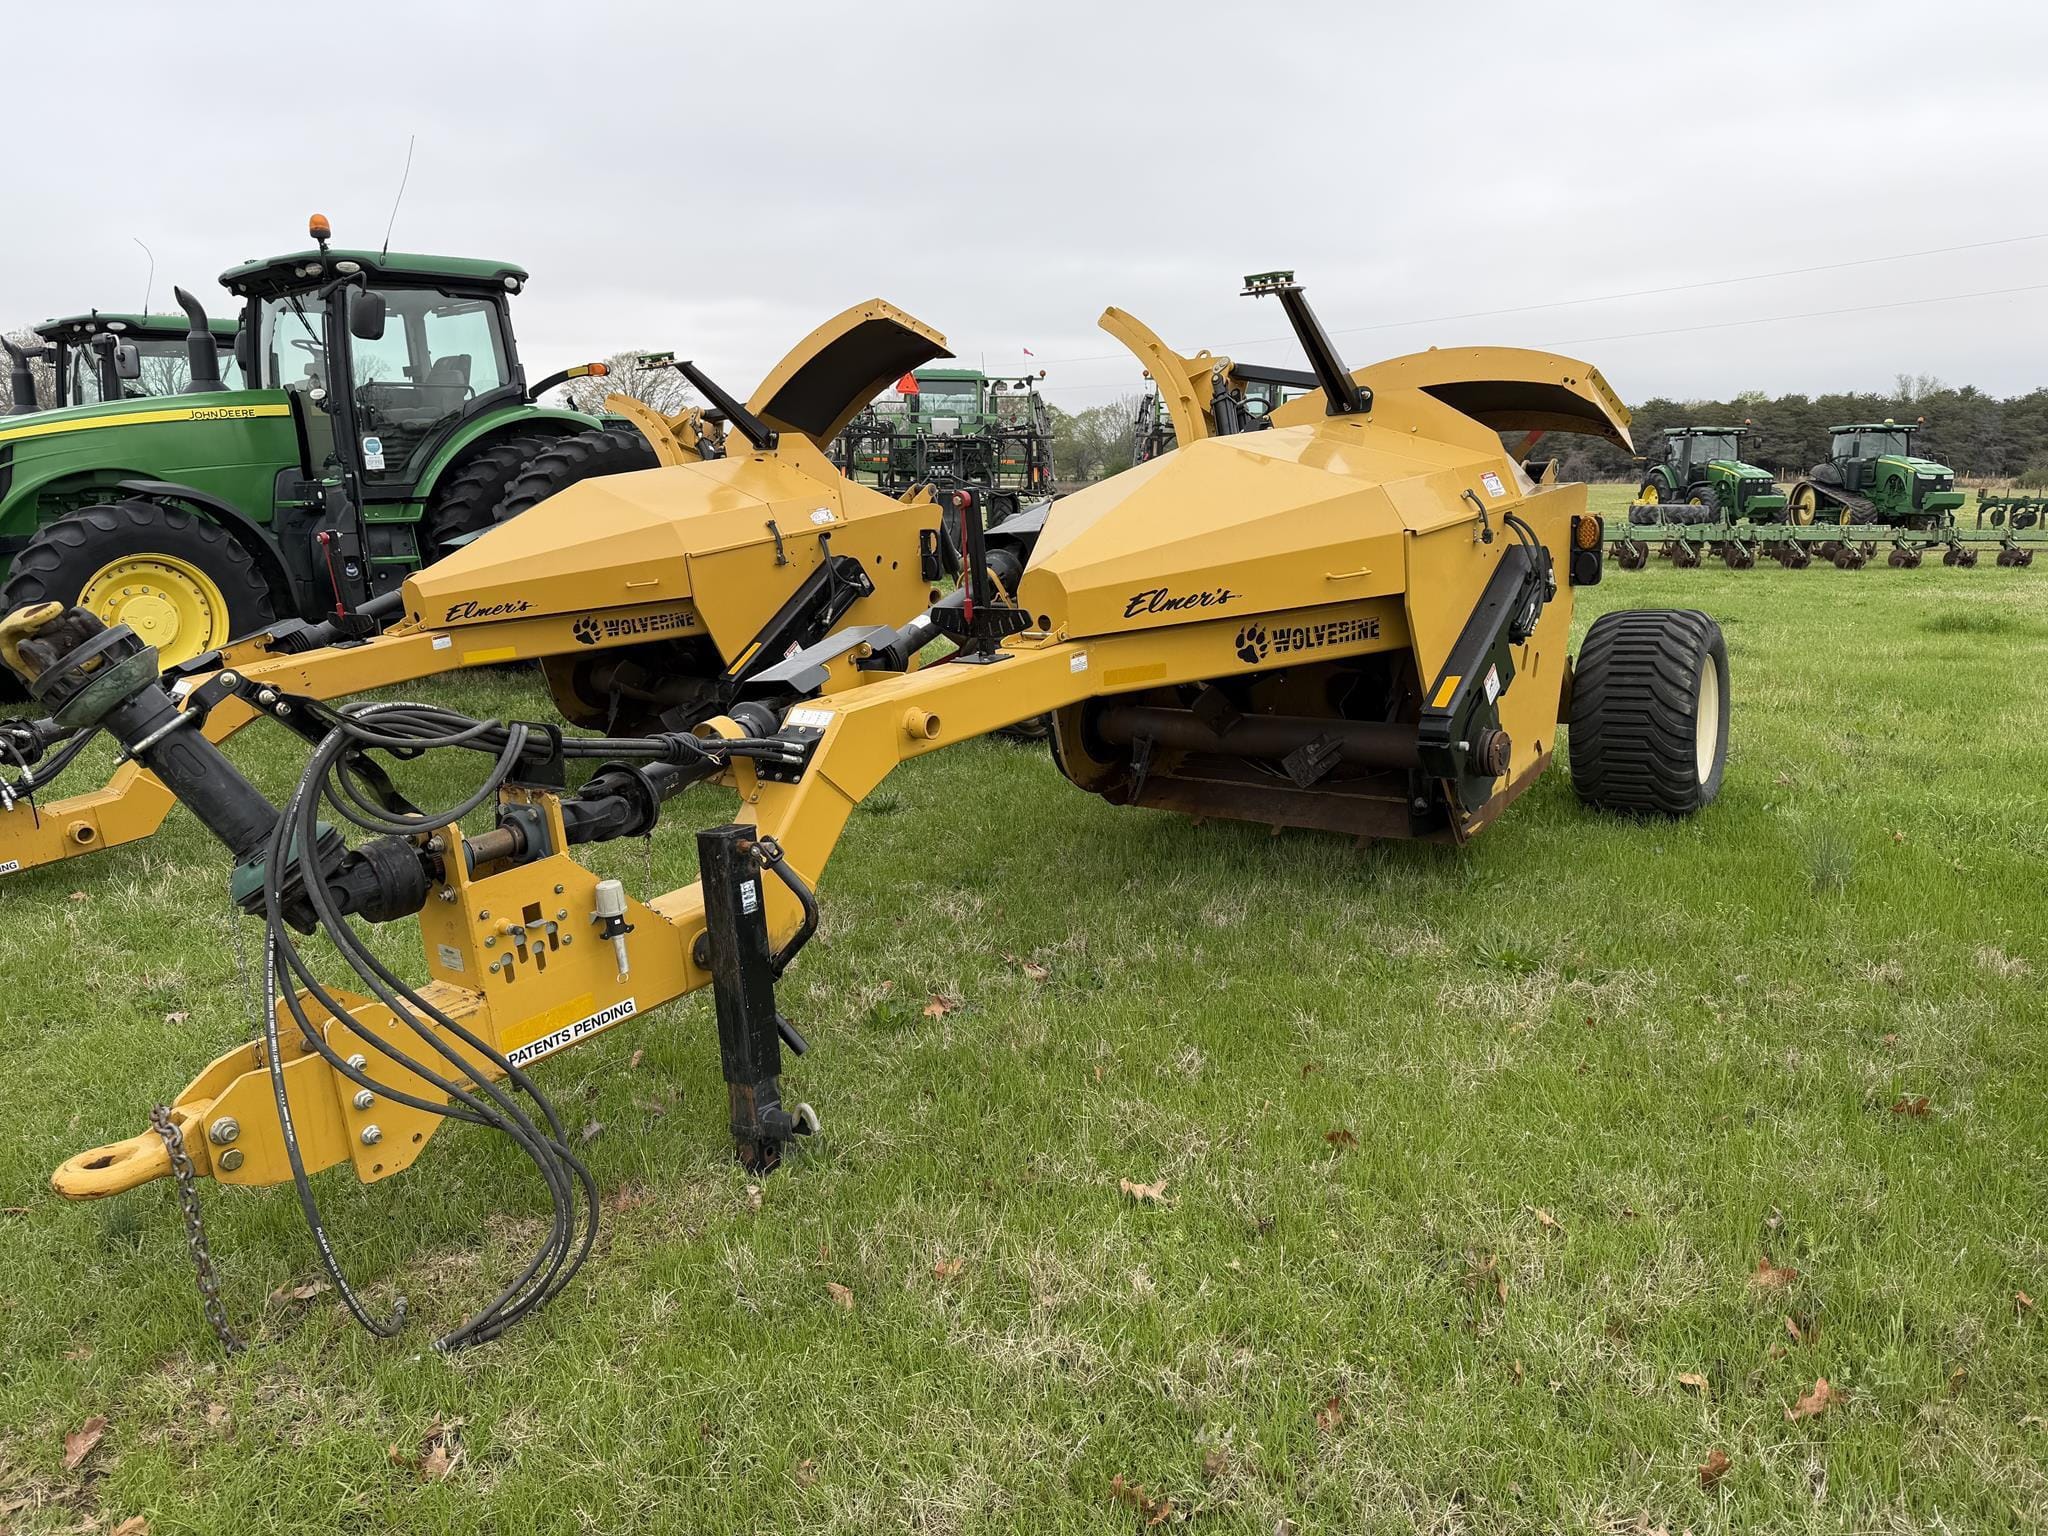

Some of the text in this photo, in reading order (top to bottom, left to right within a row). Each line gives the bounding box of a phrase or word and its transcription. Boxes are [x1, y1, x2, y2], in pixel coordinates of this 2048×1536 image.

[189, 408, 255, 419] JOHN DEERE
[445, 600, 533, 622] Elmer's
[1123, 588, 1236, 618] Elmer's
[603, 612, 695, 637] WOLVERINE
[1272, 617, 1380, 653] WOLVERINE
[508, 1001, 633, 1064] PATENTS PENDING
